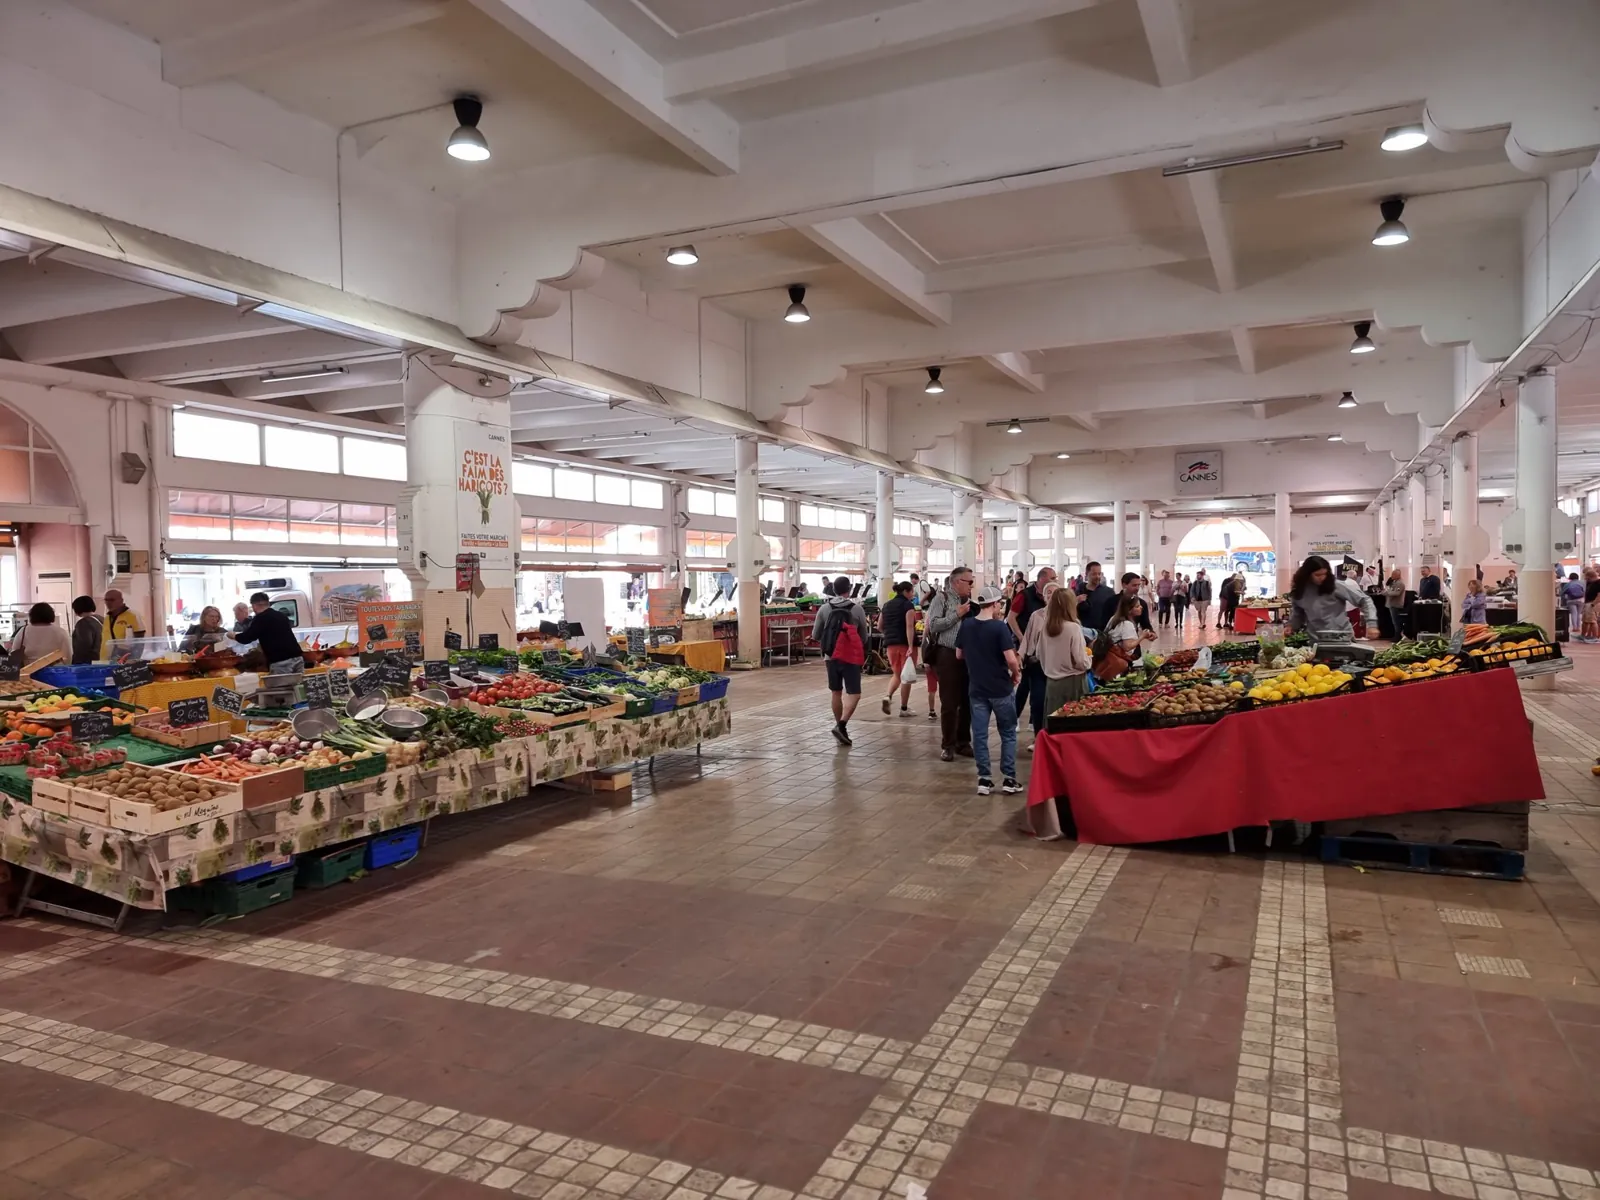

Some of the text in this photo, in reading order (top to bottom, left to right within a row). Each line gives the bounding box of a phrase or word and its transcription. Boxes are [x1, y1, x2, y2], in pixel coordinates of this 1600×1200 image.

[488, 434, 505, 442] CANNES
[464, 450, 502, 468] C'EST LA
[462, 464, 504, 482] FAIM DES
[1180, 472, 1217, 482] CANNES
[459, 477, 502, 495] HARICOTS
[397, 612, 418, 620] MAISON
